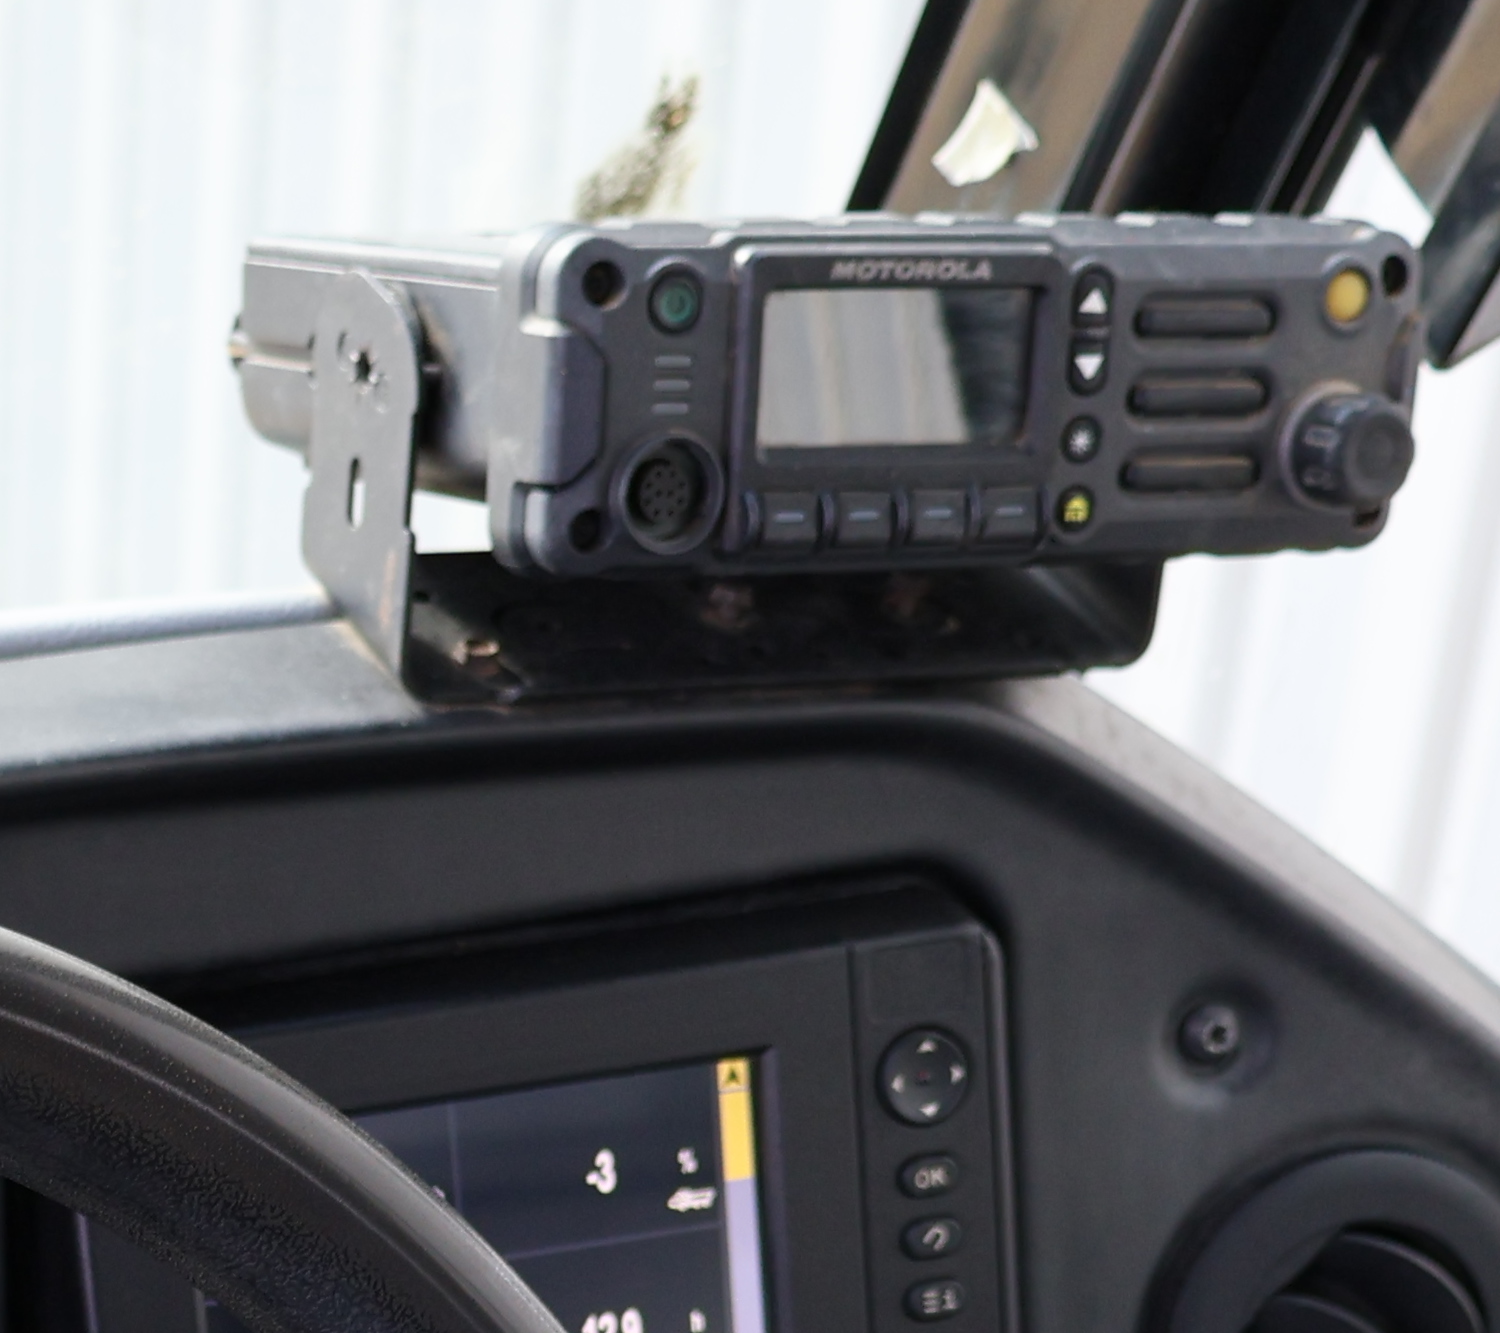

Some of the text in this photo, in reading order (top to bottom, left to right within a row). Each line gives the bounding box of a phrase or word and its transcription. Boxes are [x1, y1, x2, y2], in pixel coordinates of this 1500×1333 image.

[830, 258, 993, 282] MOTOROLA
[586, 1148, 618, 1195] -3
[914, 1166, 947, 1189] OK
